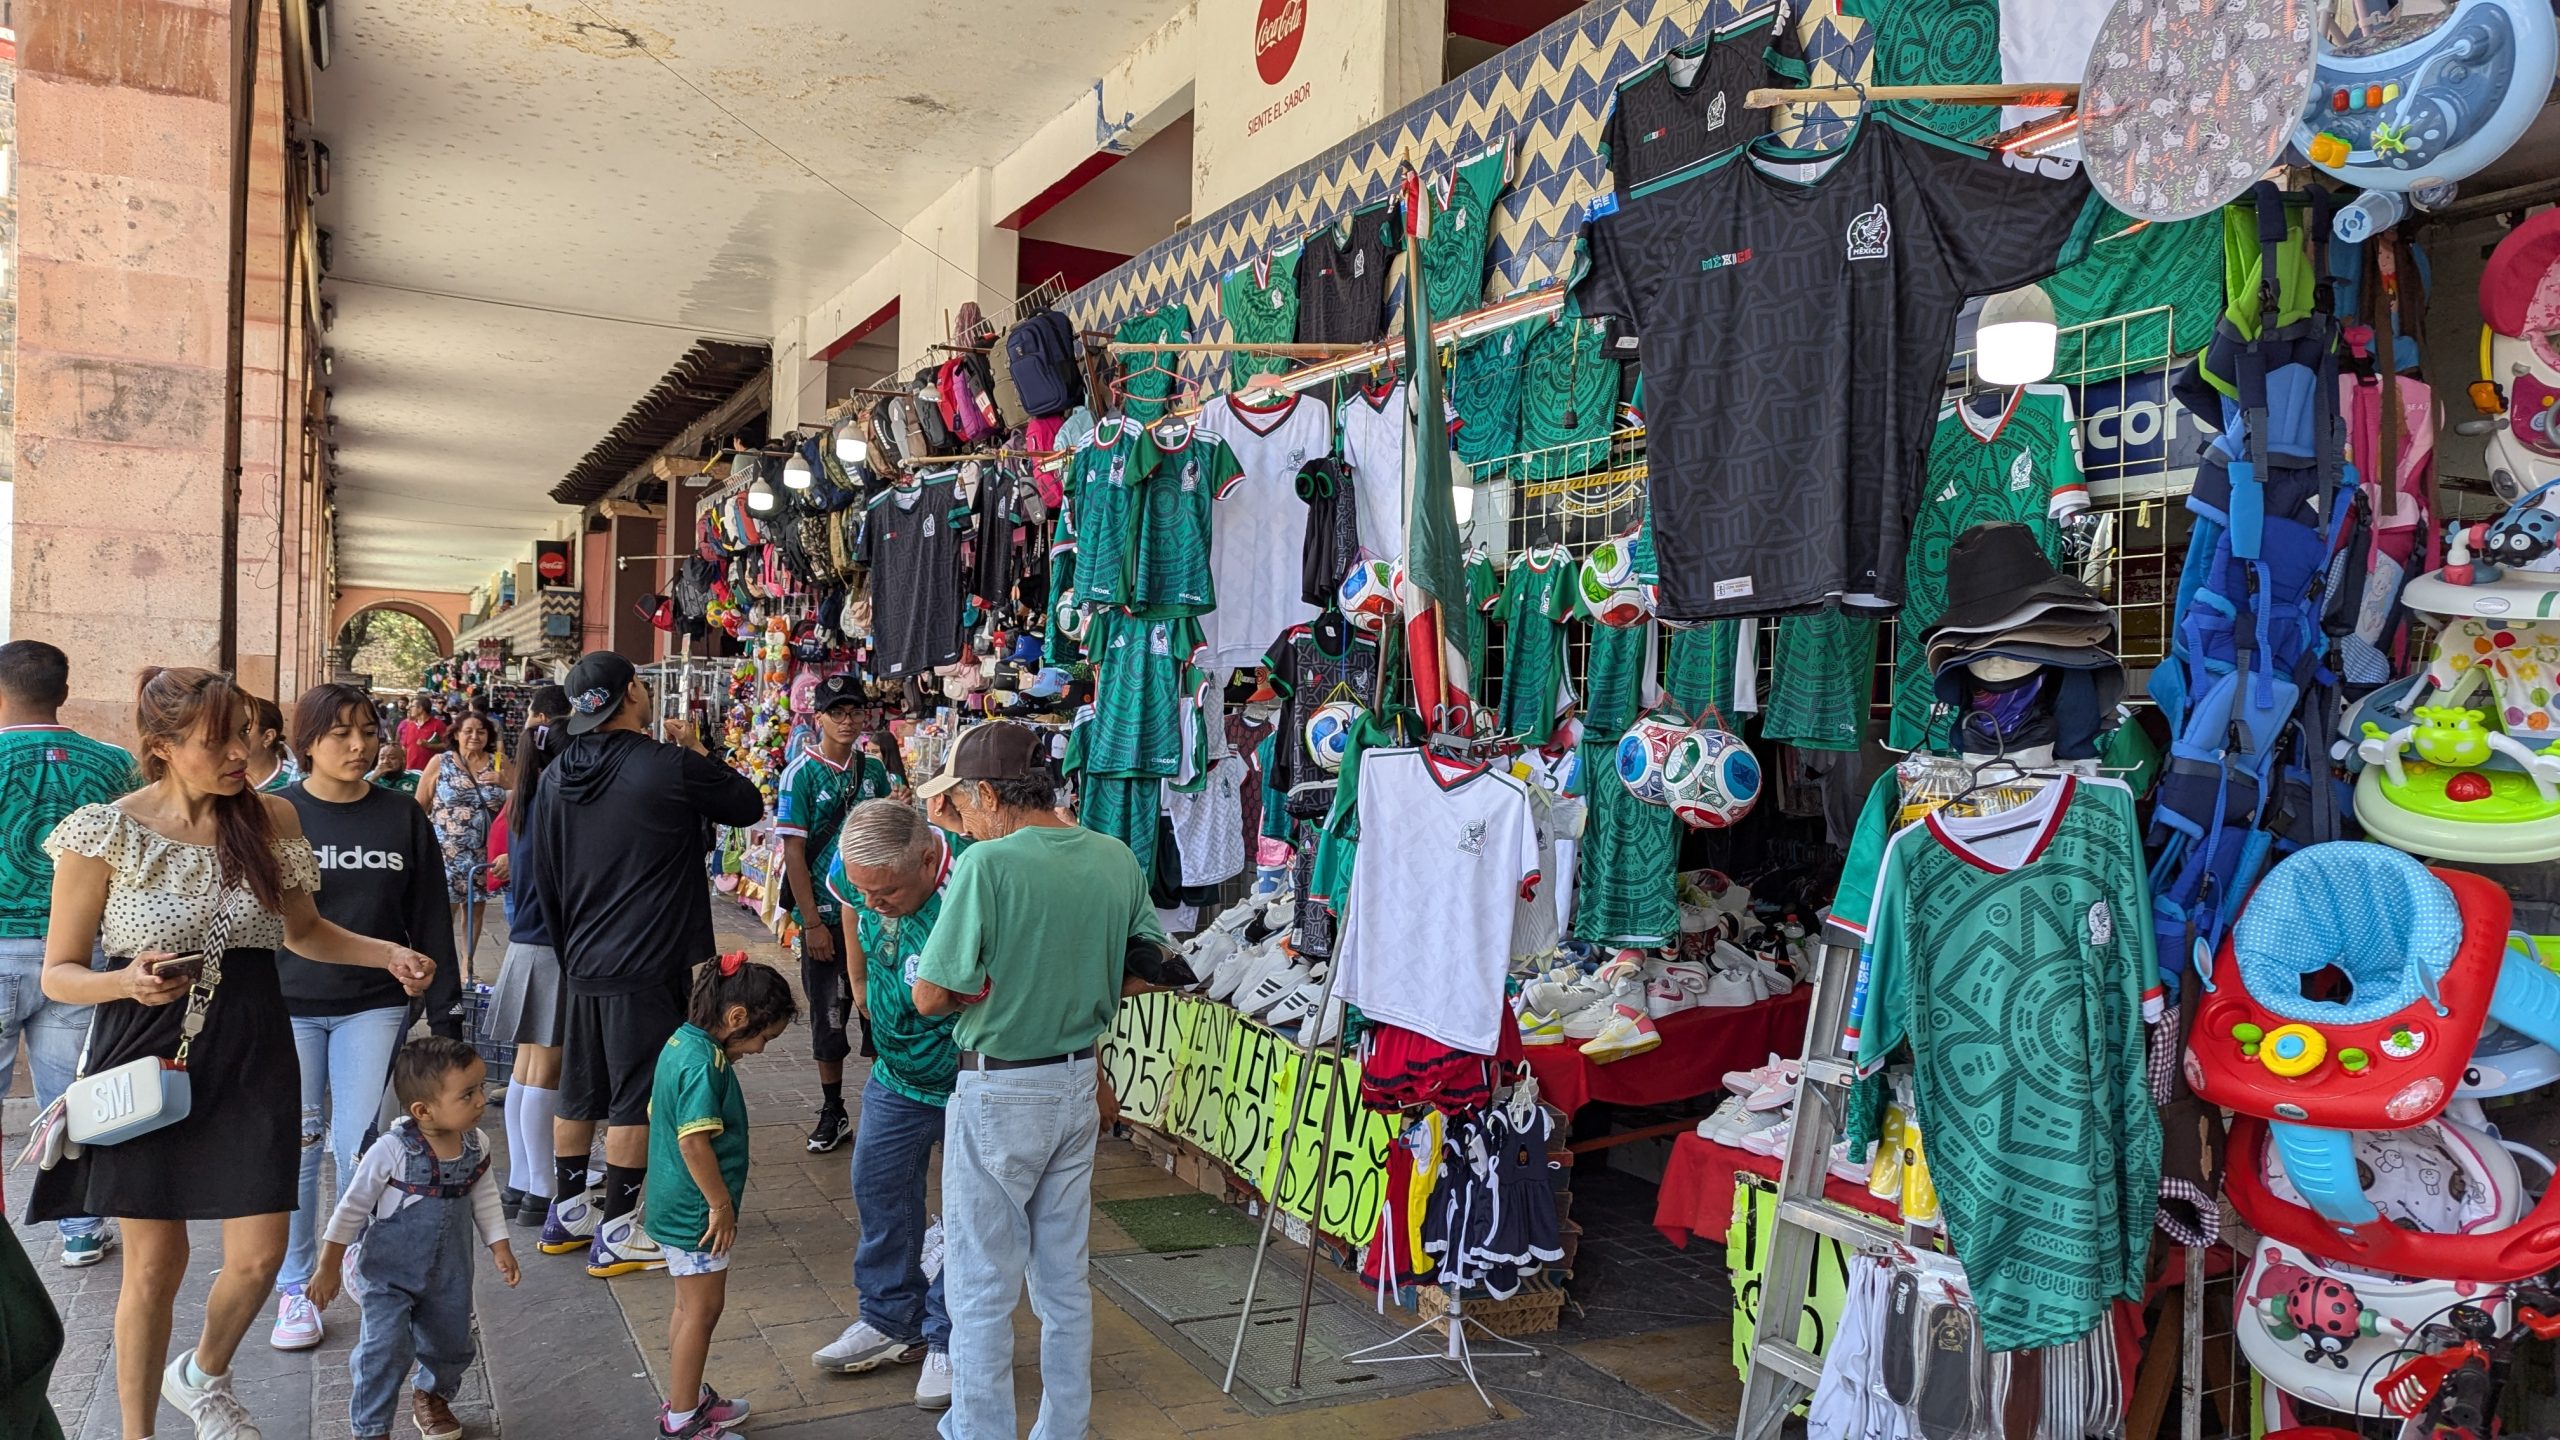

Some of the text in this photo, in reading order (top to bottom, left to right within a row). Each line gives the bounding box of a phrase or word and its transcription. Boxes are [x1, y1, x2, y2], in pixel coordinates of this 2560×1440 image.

[1247, 82, 1310, 137] SIENTE EL SABOR
[2087, 396, 2219, 450] cor
[311, 845, 404, 871] didas
[92, 1072, 134, 1123] SM
[1279, 1127, 1380, 1242] $250
